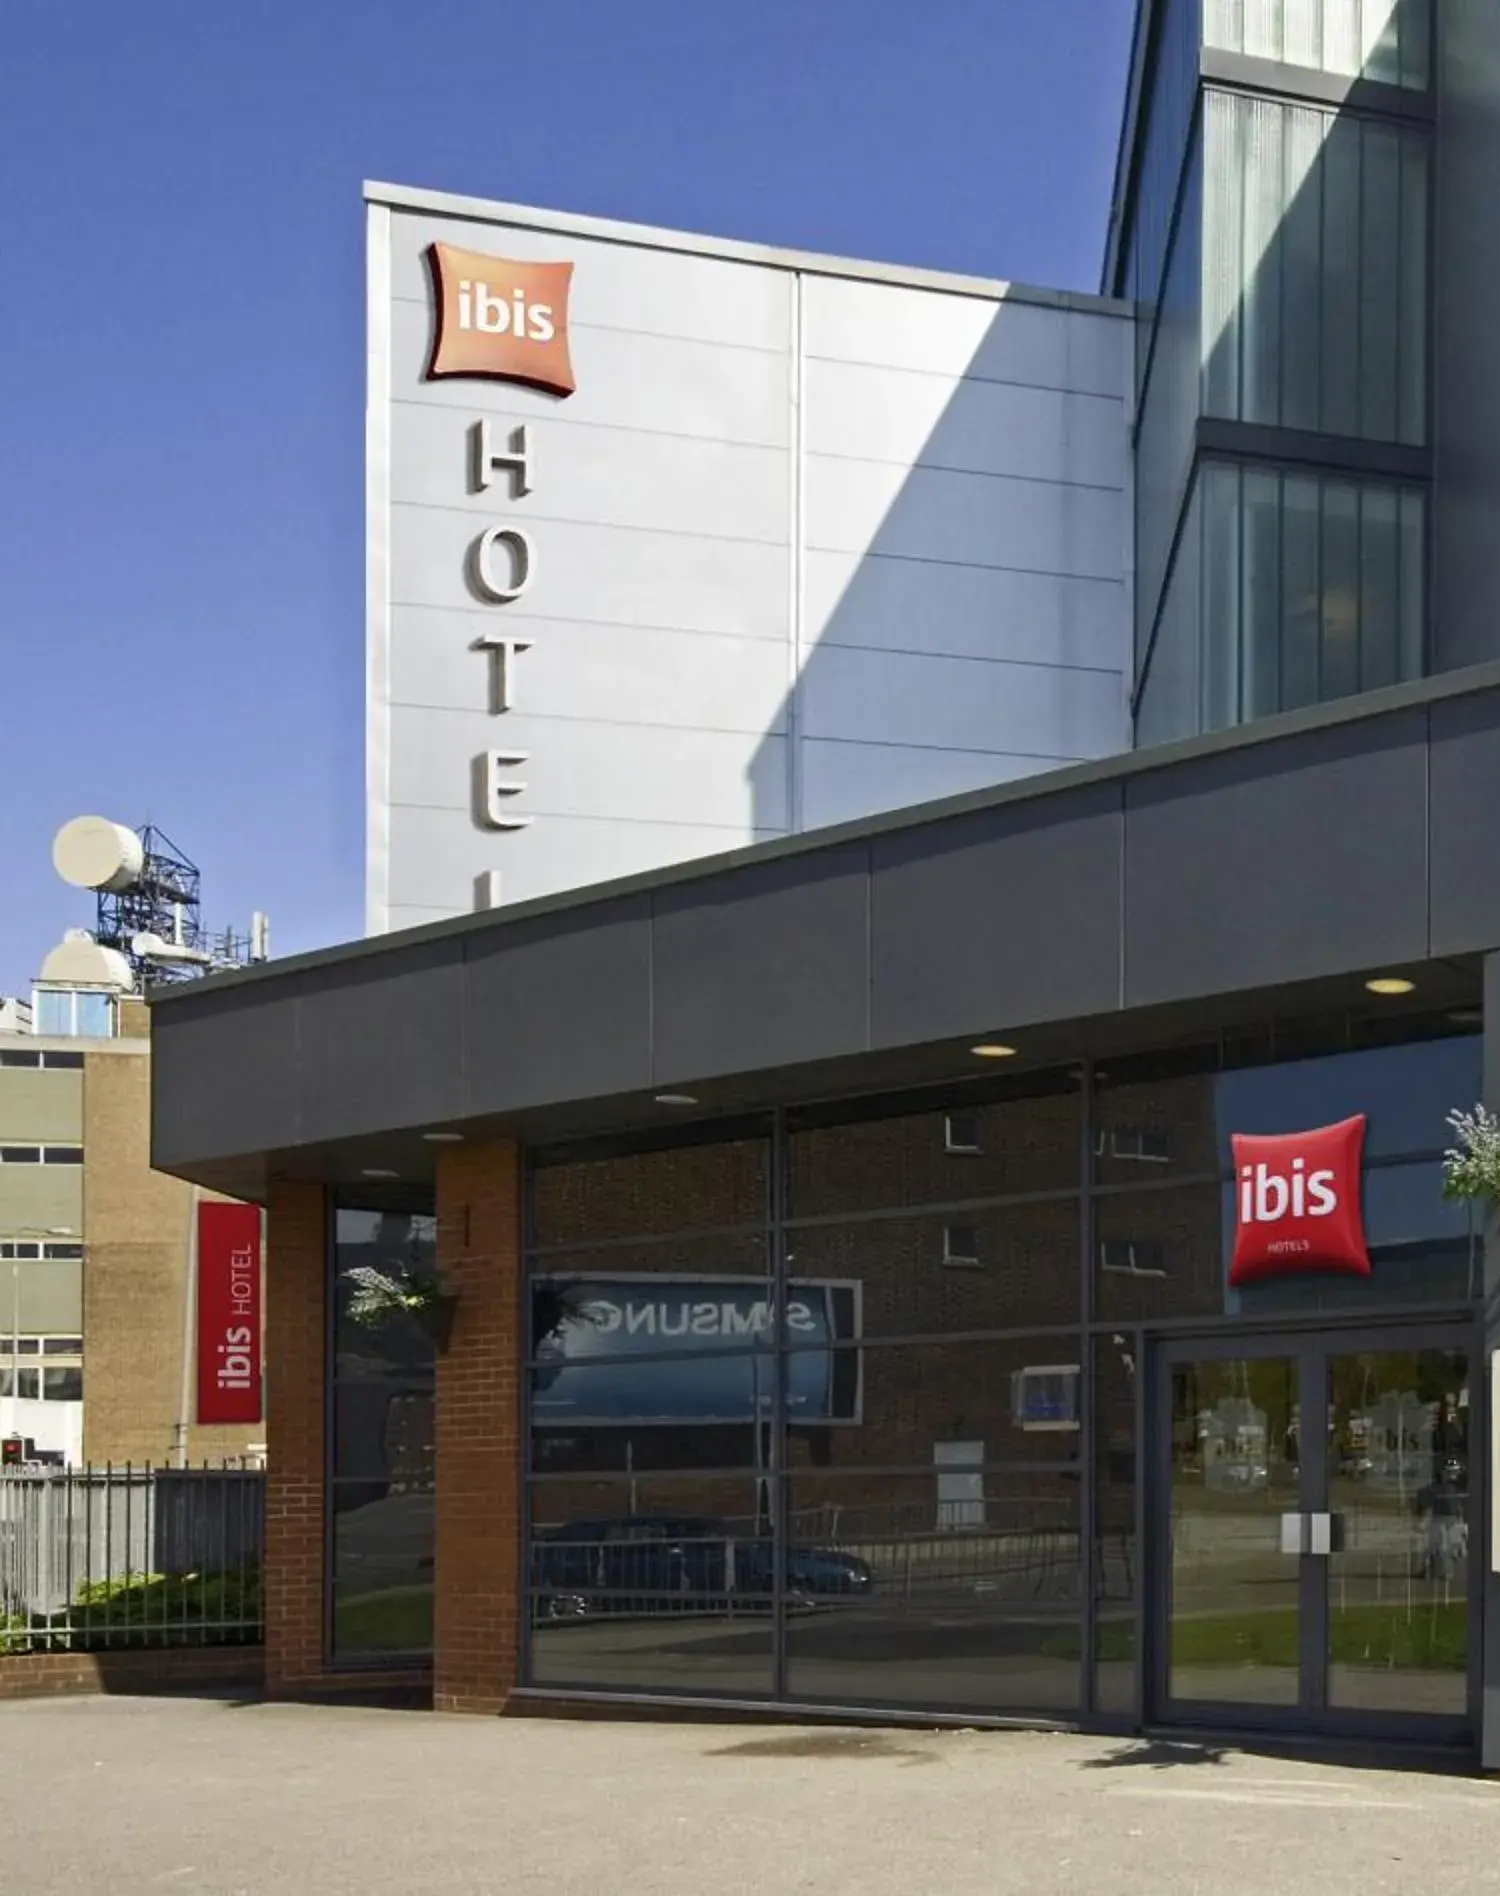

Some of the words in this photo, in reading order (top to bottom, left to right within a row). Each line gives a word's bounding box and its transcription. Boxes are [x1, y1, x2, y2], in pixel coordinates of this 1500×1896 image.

[459, 280, 554, 341] ibis
[1241, 1158, 1337, 1224] ibis
[1267, 1239, 1310, 1254] HOTELS
[231, 1242, 252, 1315] HOTEL
[217, 1326, 251, 1389] ibis
